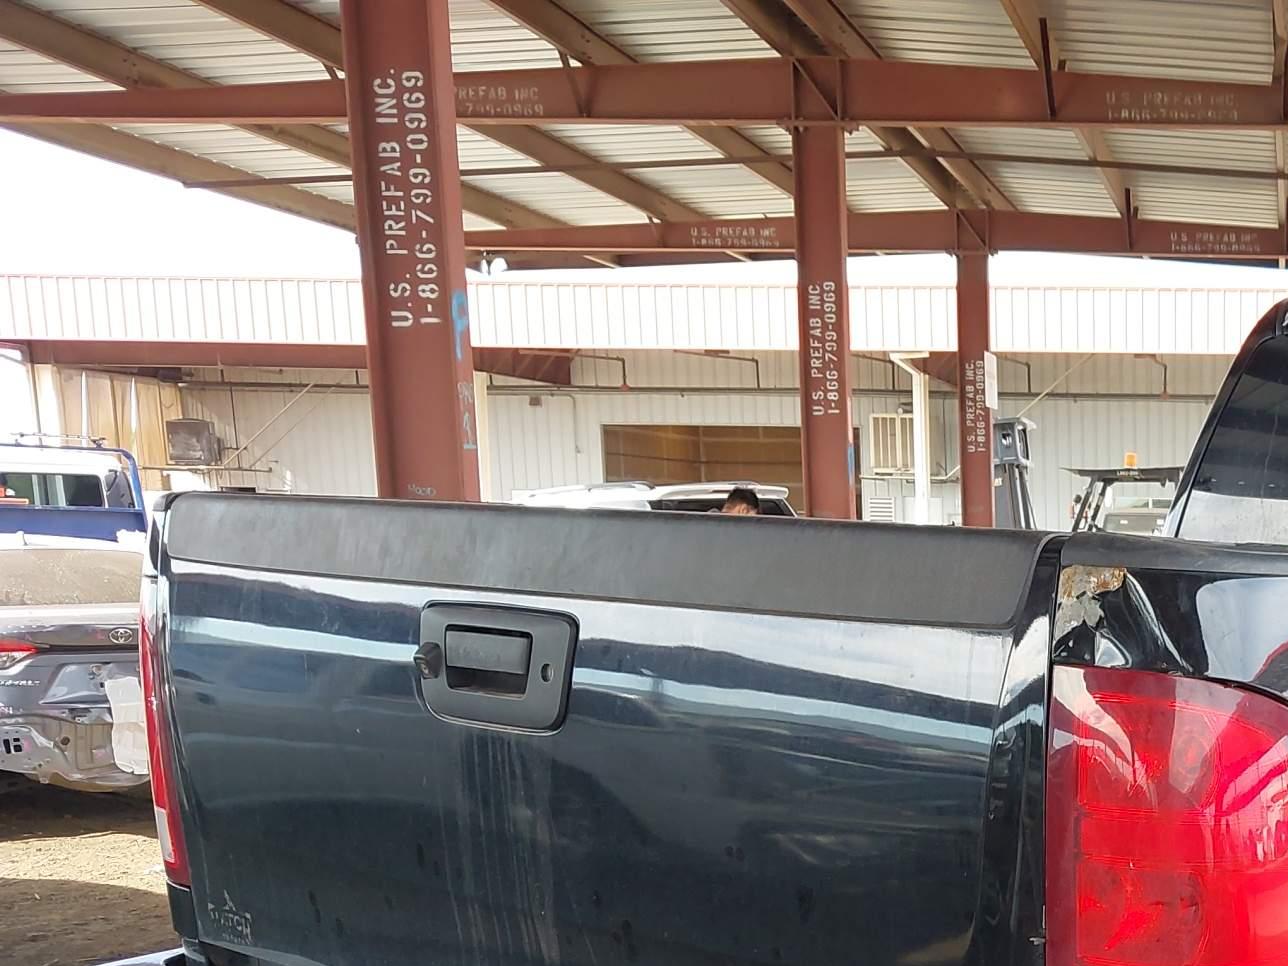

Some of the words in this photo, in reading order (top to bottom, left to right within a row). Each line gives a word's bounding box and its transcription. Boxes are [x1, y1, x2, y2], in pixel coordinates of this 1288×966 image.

[372, 68, 399, 124] INC.
[455, 86, 507, 100] REFAB
[377, 140, 409, 255] PREFAB
[401, 70, 442, 325] 1-866-799-0969
[388, 272, 415, 327] U.S.
[807, 280, 821, 310] INC.
[809, 317, 824, 378] PREFAB
[823, 281, 840, 415] 1-866-799-0969
[811, 385, 825, 417] U.S.
[965, 384, 976, 427] PREFAB
